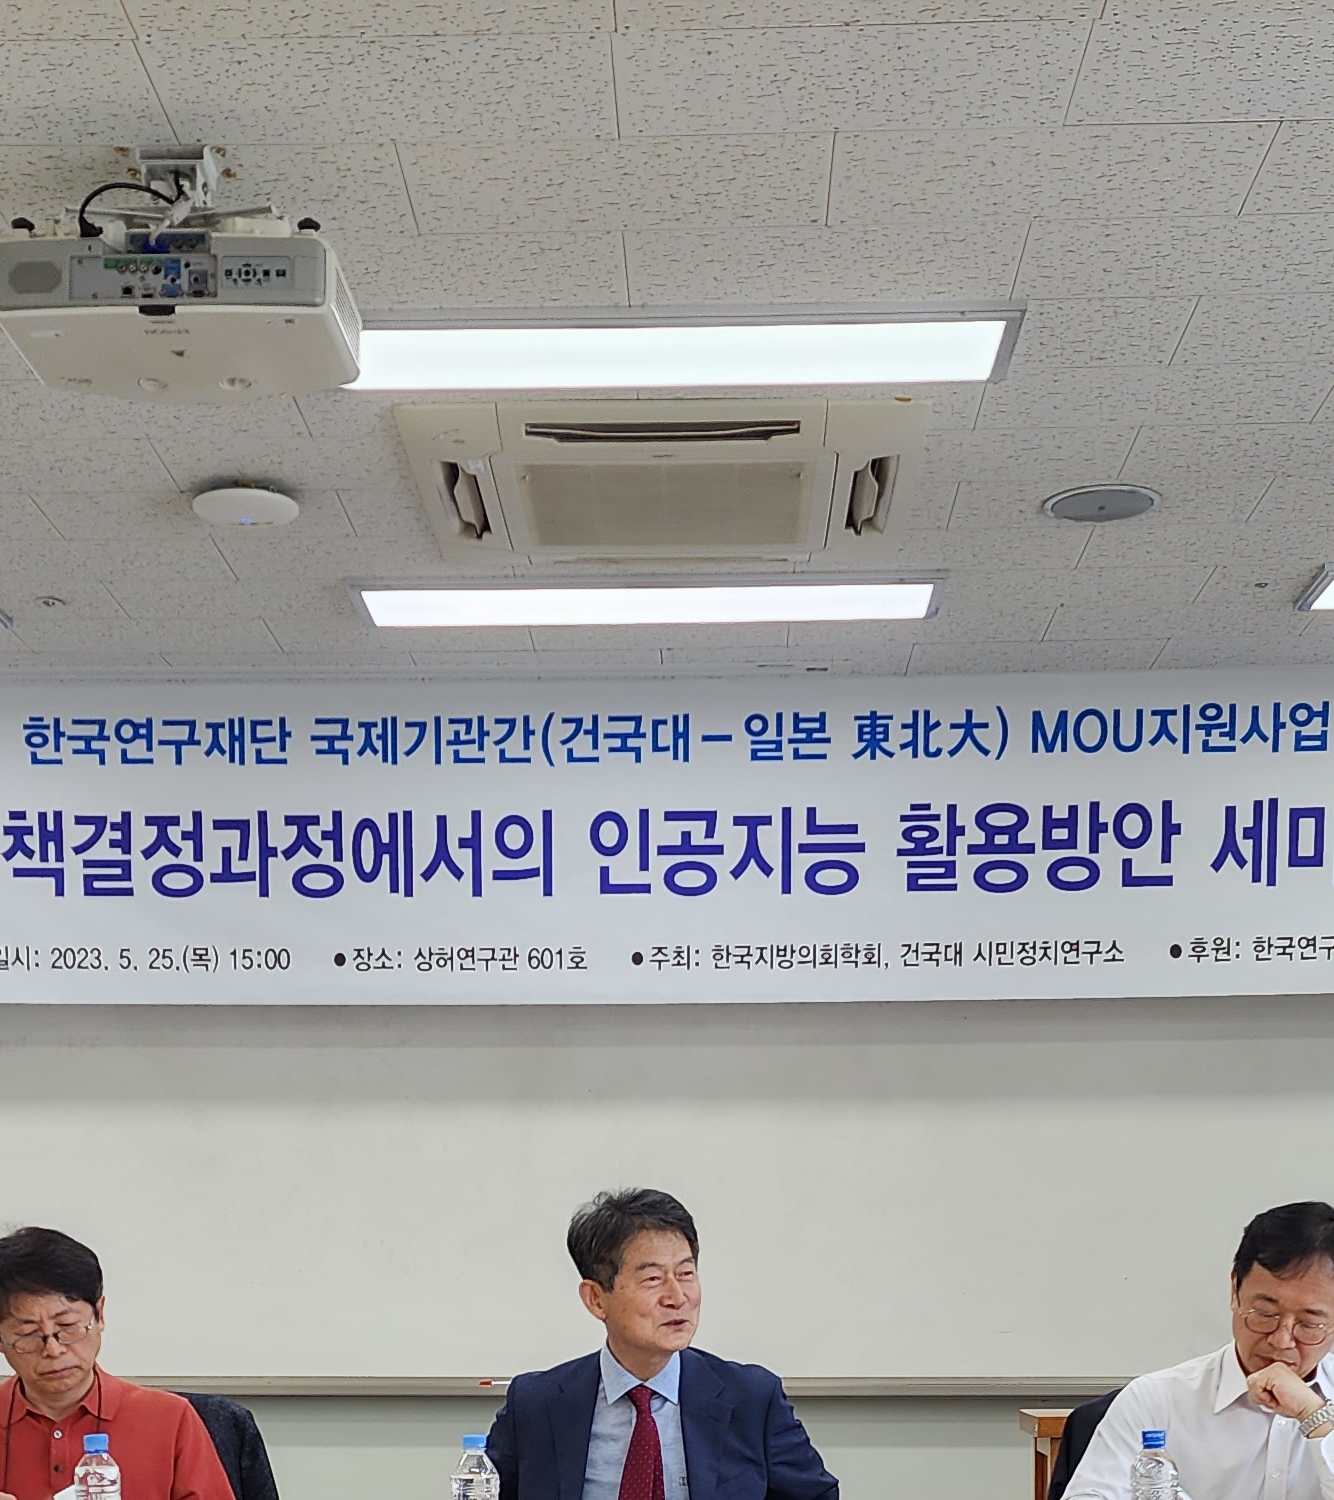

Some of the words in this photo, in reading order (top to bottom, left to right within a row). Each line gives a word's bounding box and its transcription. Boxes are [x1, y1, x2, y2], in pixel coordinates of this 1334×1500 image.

[23, 715, 292, 767] 한국연구재단
[852, 704, 1008, 761] 東北大)
[1032, 700, 1329, 755] MOU지원사업
[590, 805, 865, 897] 인공지능
[896, 799, 1182, 894] 활용방안
[50, 947, 109, 971] 2023.
[118, 947, 138, 972] 5.
[148, 944, 219, 974] 25.(목)
[229, 947, 291, 971] 15:00
[352, 946, 403, 972] 장소:
[413, 945, 520, 973] 상허연구관
[527, 945, 588, 970] 601호
[648, 944, 700, 971] 주최:
[711, 942, 889, 971] 한국지방의회학회,
[899, 940, 963, 968] 건국대
[972, 939, 1125, 968] 시민정치연구소
[1187, 936, 1241, 964] 후원:
